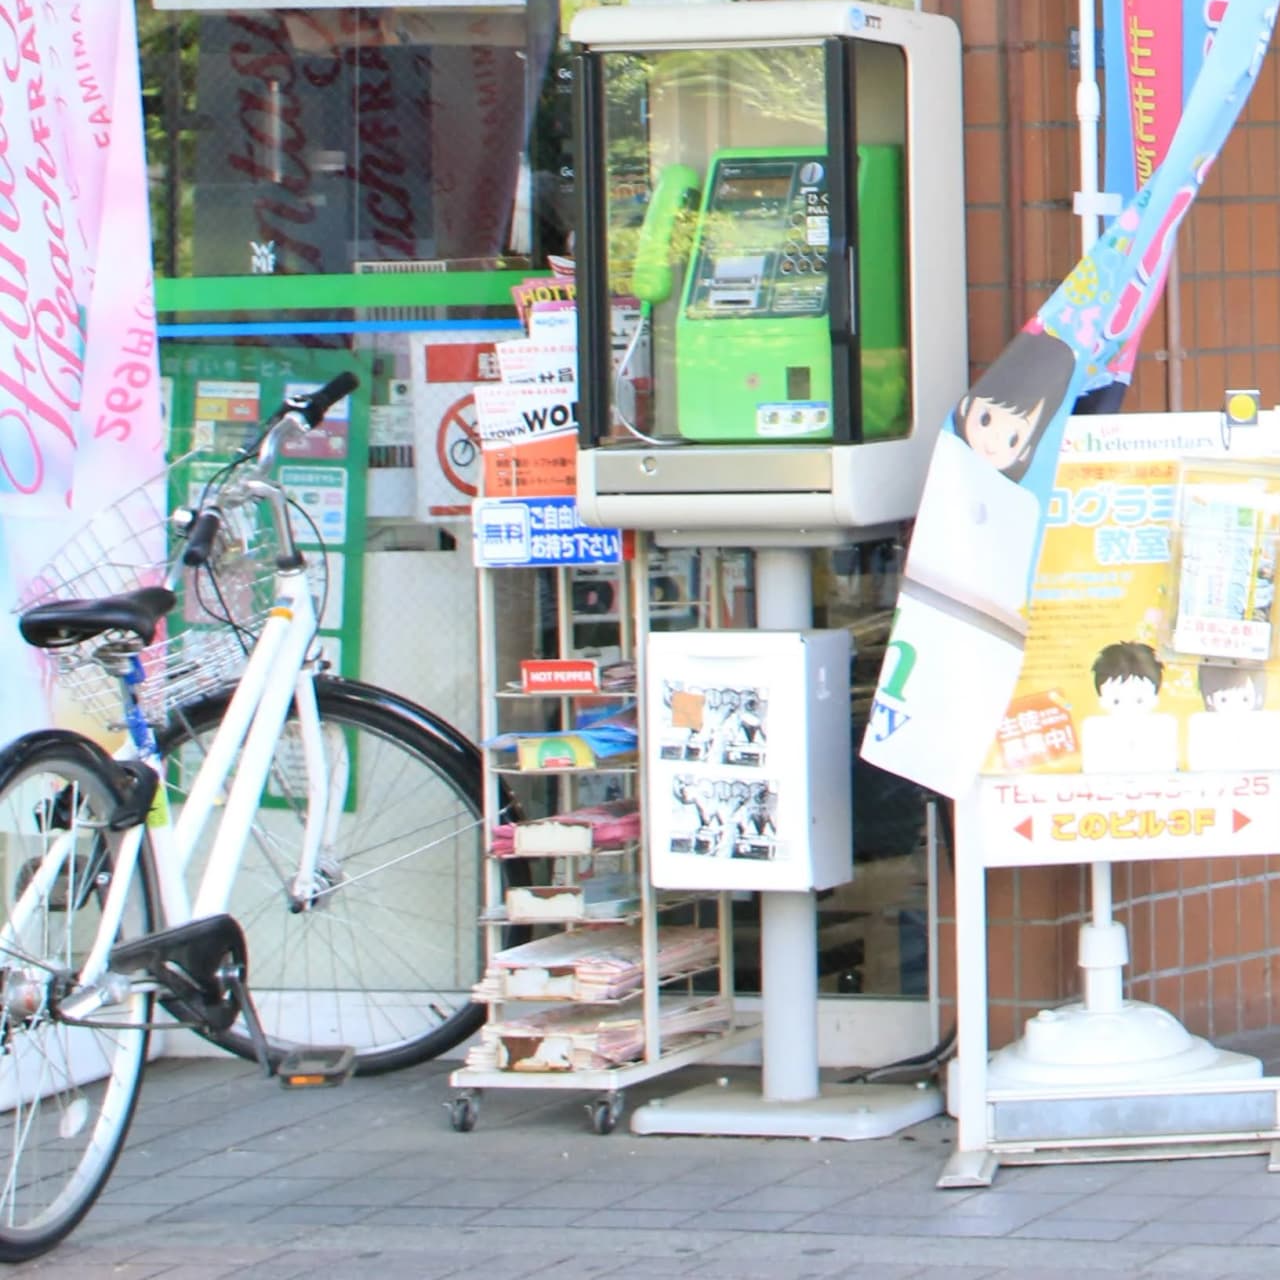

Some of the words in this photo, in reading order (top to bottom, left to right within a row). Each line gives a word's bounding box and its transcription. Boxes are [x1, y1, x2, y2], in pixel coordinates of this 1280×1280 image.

[70, 3, 112, 150] FAMIMA
[530, 533, 619, 558] お持ち下さい
[1099, 525, 1170, 561] 教室
[1050, 808, 1217, 841] このビル3F
